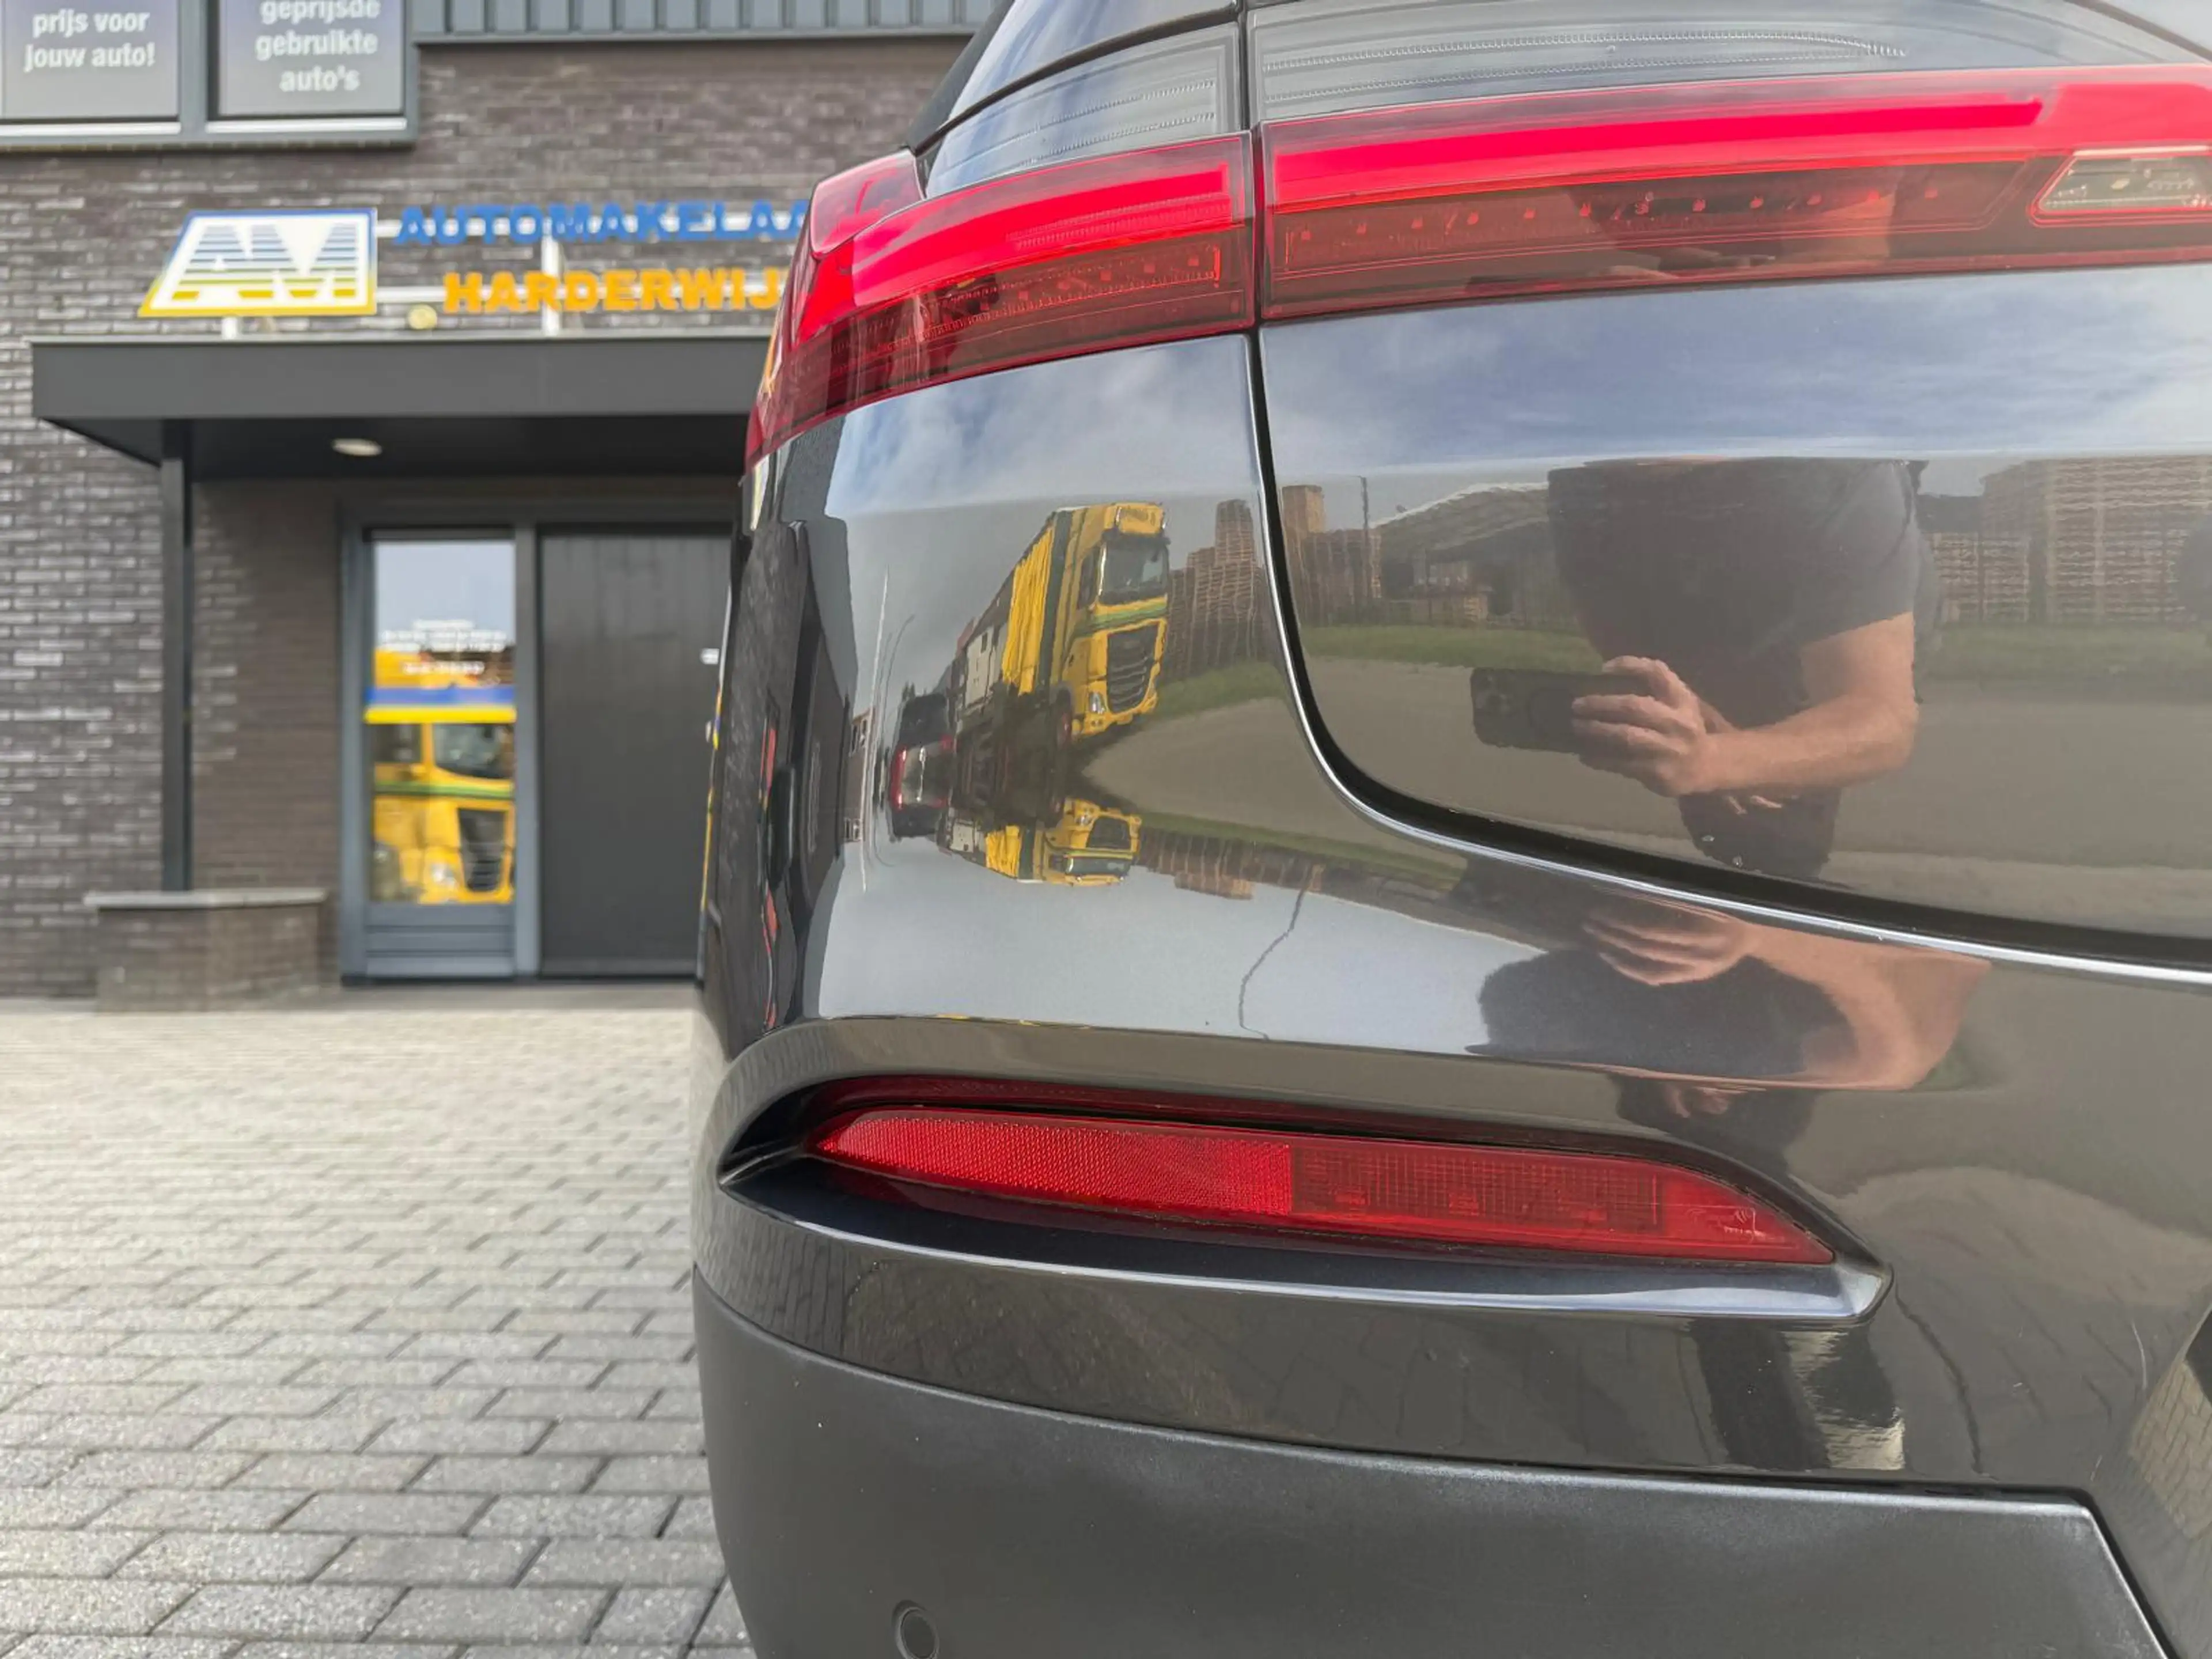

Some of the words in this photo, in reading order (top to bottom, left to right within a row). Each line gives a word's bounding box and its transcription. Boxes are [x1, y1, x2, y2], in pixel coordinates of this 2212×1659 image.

[33, 9, 88, 37] prijs
[95, 12, 149, 33] voor
[24, 43, 84, 72] jouw
[92, 43, 155, 67] auto!
[255, 29, 377, 60] gebruikte
[279, 66, 359, 92] auto's
[444, 267, 788, 312] HARDERWIJ
